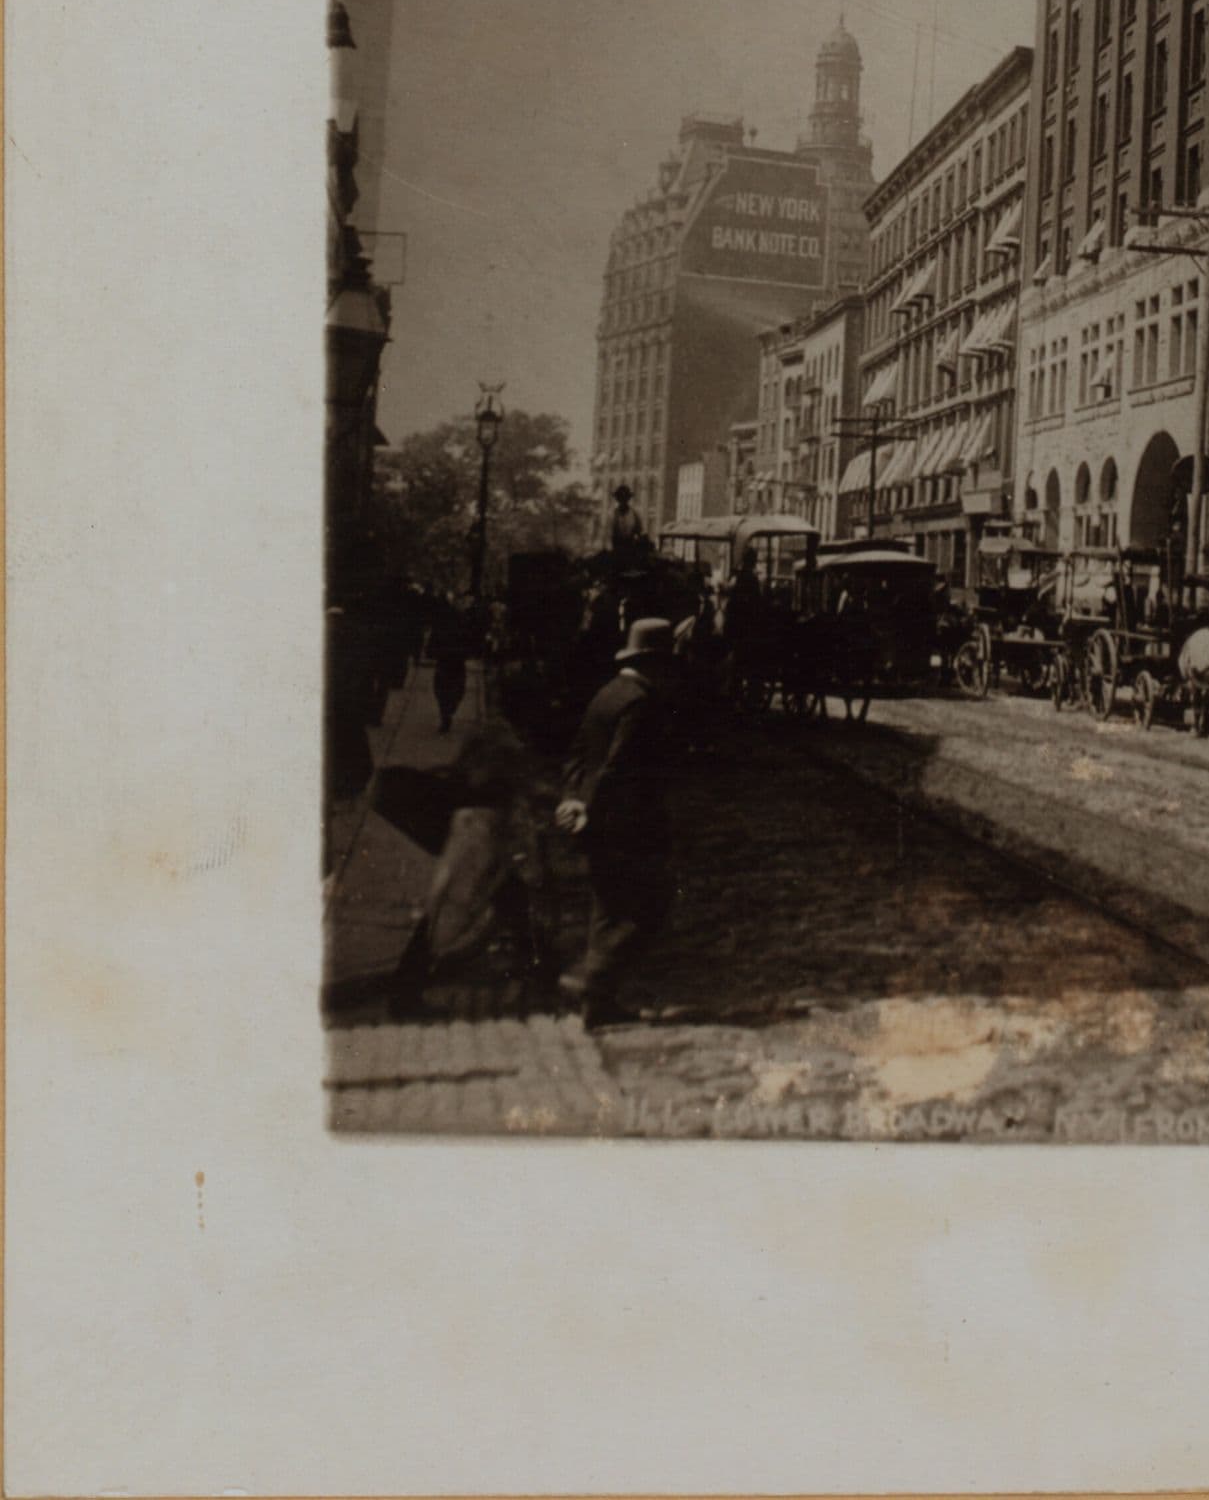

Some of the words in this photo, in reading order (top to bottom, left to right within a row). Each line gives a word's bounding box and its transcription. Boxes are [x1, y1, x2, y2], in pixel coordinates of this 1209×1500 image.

[735, 191, 775, 218] NEW
[778, 196, 820, 221] YORK
[711, 225, 757, 252] BANK
[758, 231, 797, 256] NOTE
